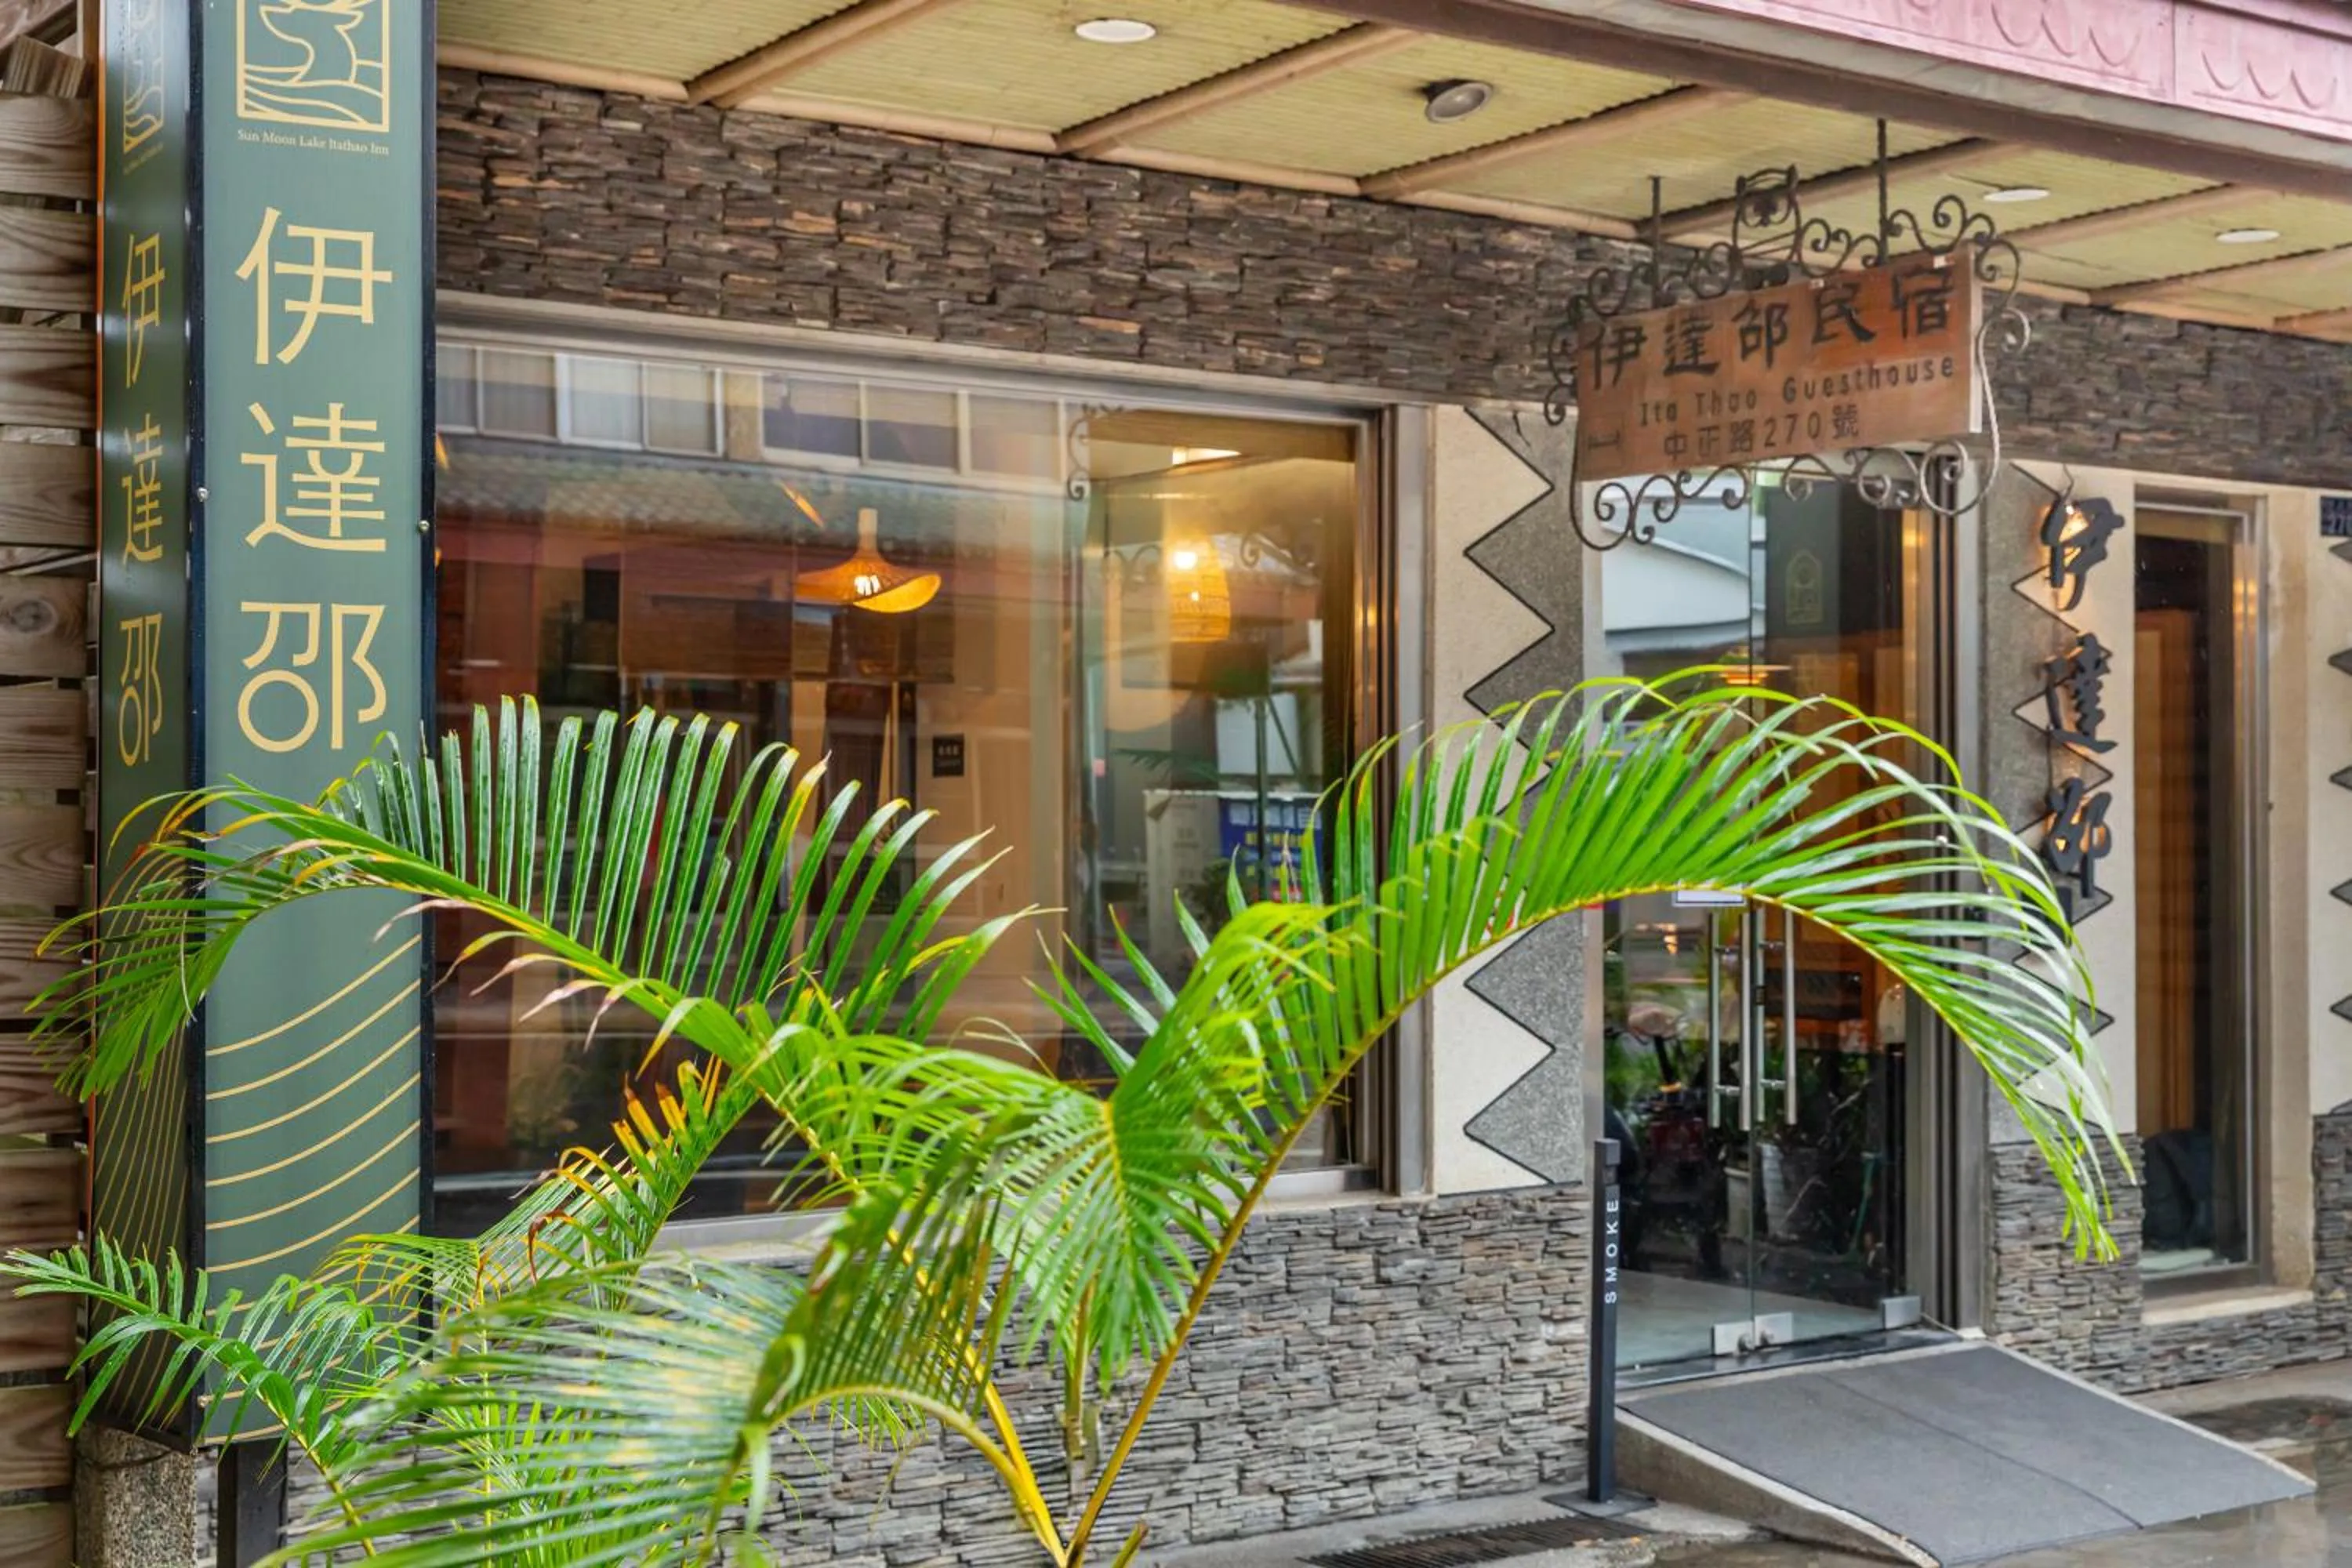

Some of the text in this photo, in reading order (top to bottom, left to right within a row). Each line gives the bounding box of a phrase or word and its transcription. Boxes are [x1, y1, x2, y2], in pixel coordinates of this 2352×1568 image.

[238, 129, 260, 141] Sun
[263, 132, 296, 145] Moon
[299, 136, 327, 149] Lake
[371, 142, 390, 155] Inn
[1587, 265, 1955, 390] 伊達邵民宿
[1695, 389, 1758, 416] Thao
[1782, 355, 1955, 403] Guesthouse
[119, 233, 165, 767] 伊達邵
[235, 206, 393, 753] 伊達邵
[1604, 1199, 1620, 1305] SMOKE
